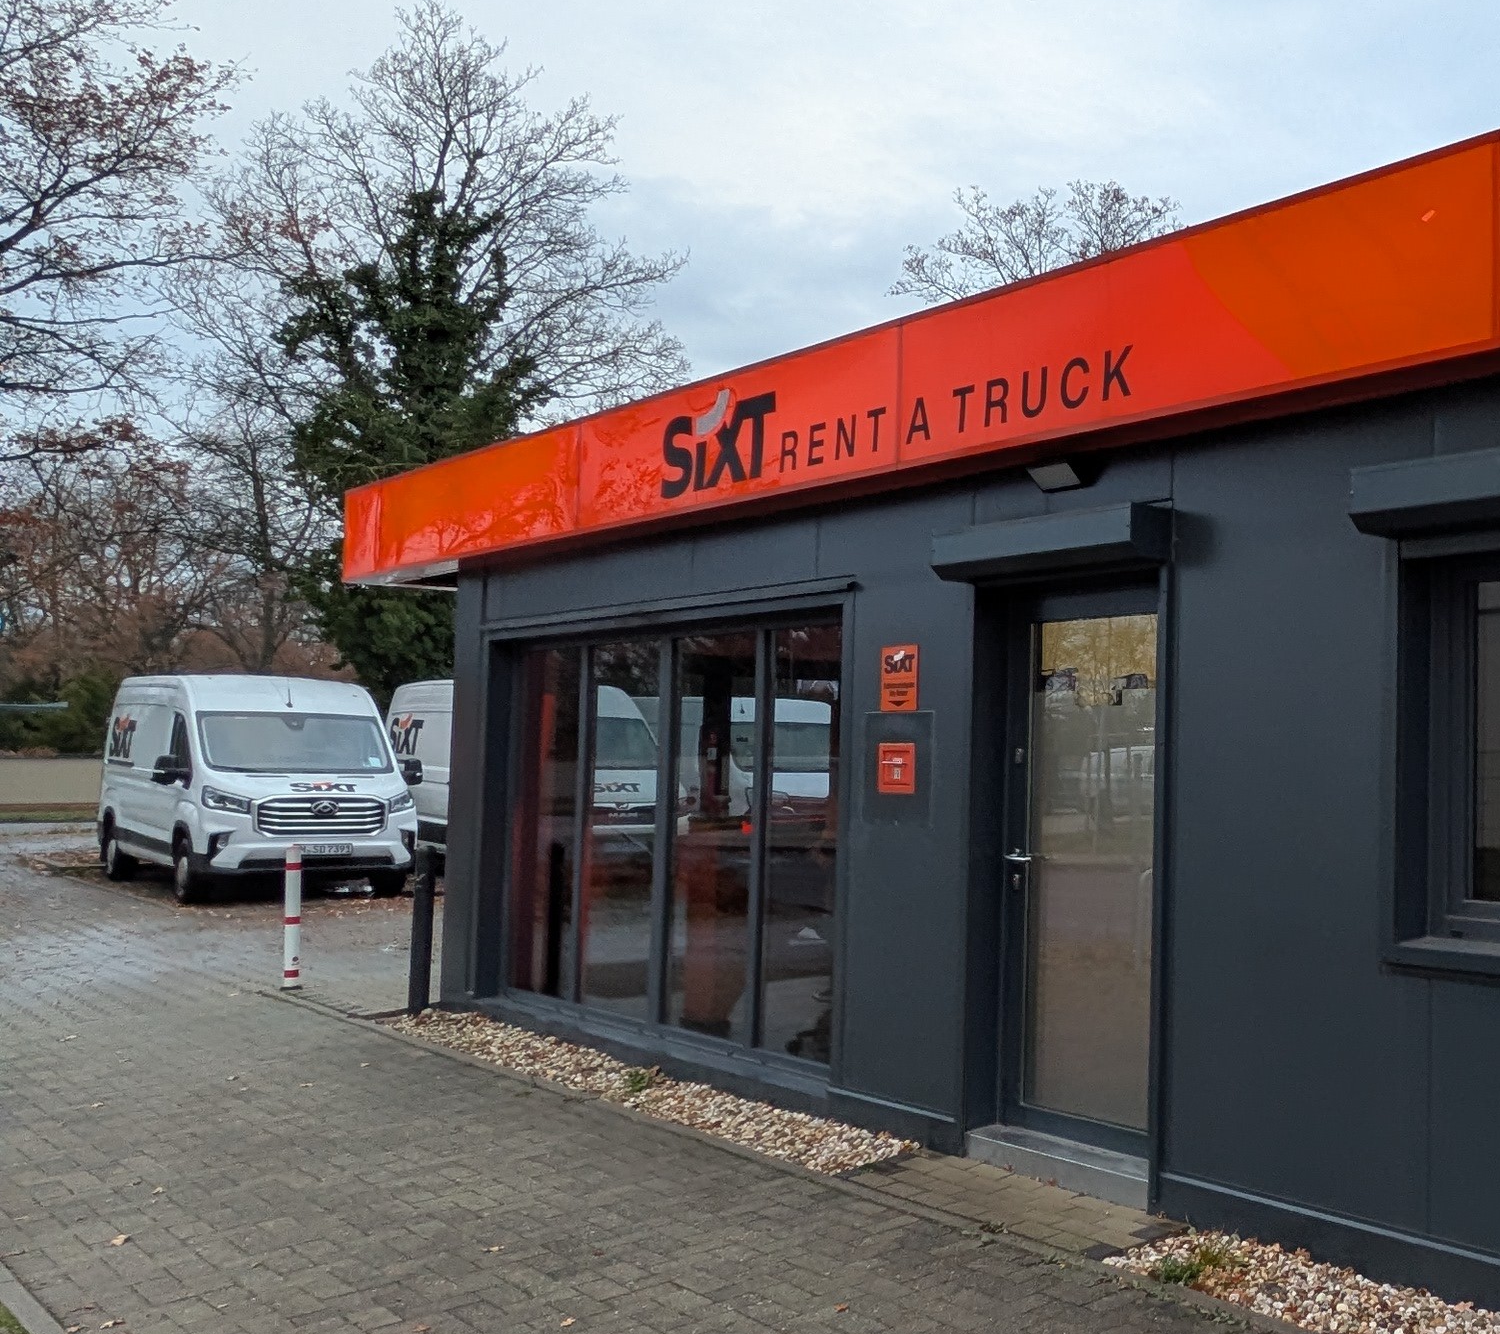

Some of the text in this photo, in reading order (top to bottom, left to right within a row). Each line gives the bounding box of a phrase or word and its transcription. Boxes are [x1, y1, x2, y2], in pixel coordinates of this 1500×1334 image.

[779, 407, 887, 473] RENT
[906, 397, 931, 445] A
[953, 344, 1134, 434] TRUCK
